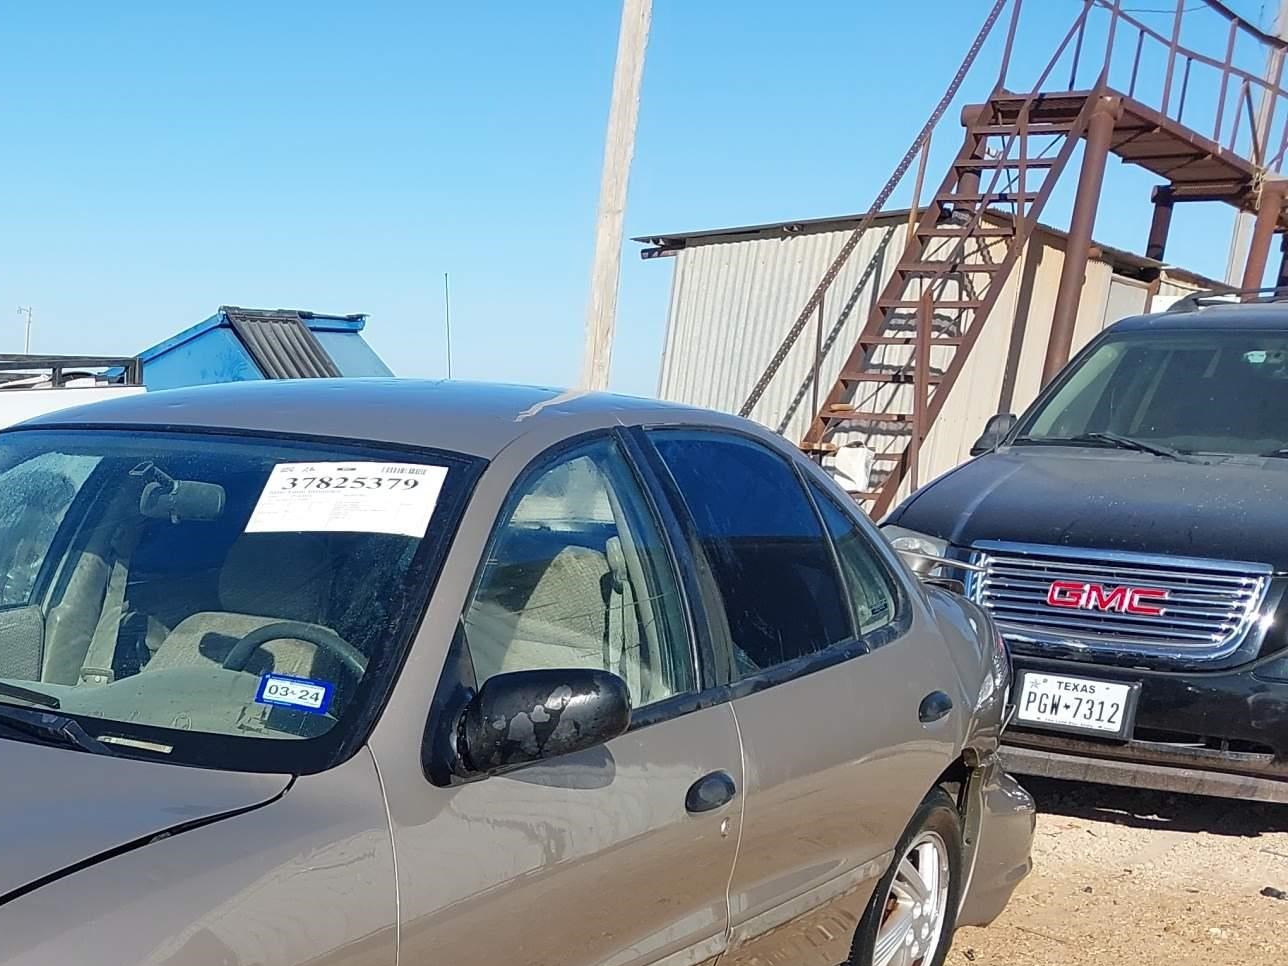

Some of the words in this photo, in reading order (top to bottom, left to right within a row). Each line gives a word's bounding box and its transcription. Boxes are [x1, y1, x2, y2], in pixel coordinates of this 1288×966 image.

[281, 476, 420, 491] 37825379
[1047, 580, 1169, 615] GMC
[1056, 680, 1096, 694] TEXAS
